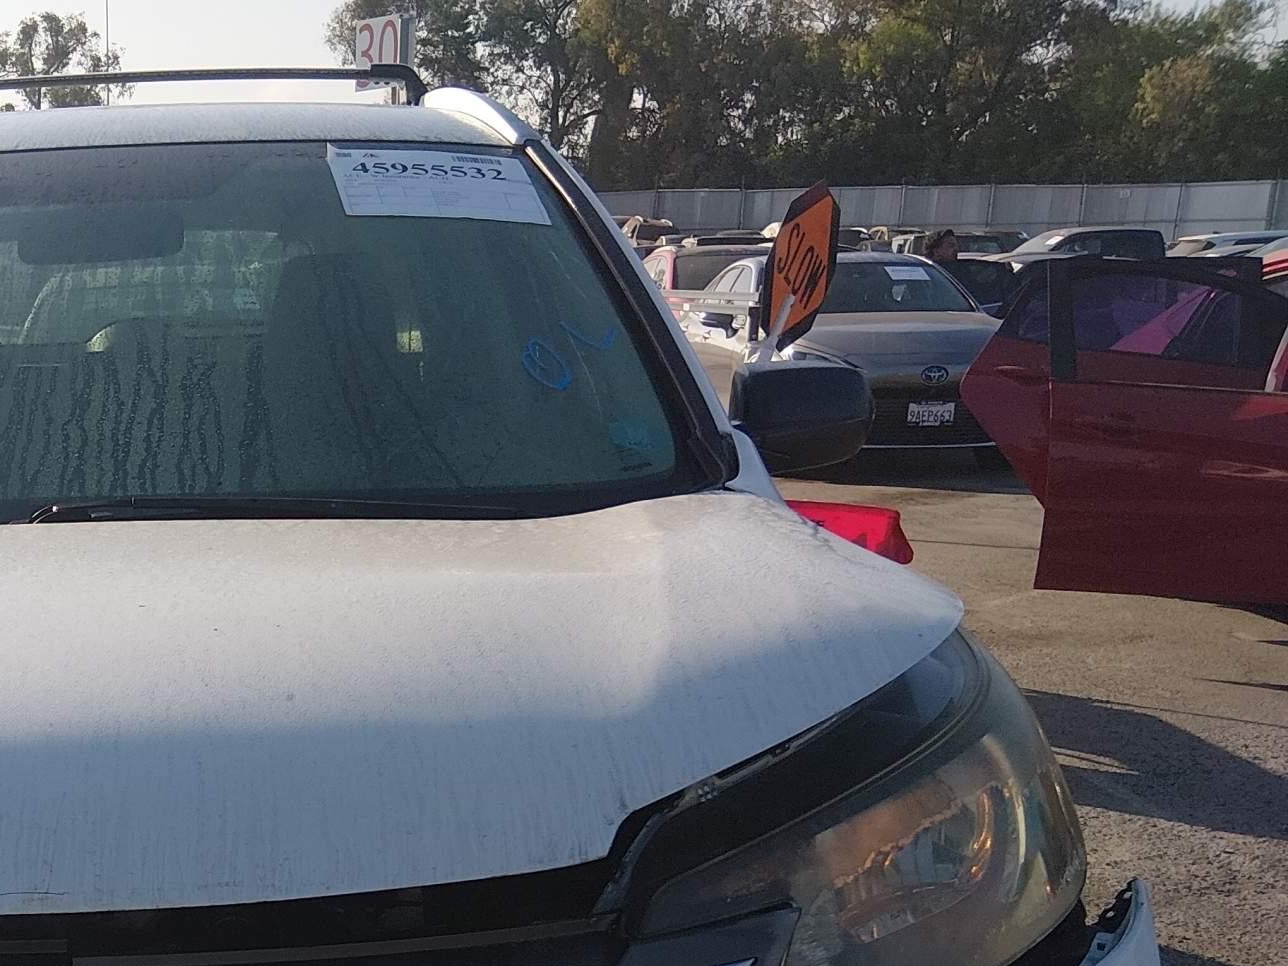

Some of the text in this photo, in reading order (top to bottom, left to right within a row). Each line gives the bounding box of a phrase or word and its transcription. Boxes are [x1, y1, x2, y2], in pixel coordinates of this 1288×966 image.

[359, 19, 399, 87] 30
[352, 161, 507, 182] 45955532
[777, 223, 826, 310] SLOW
